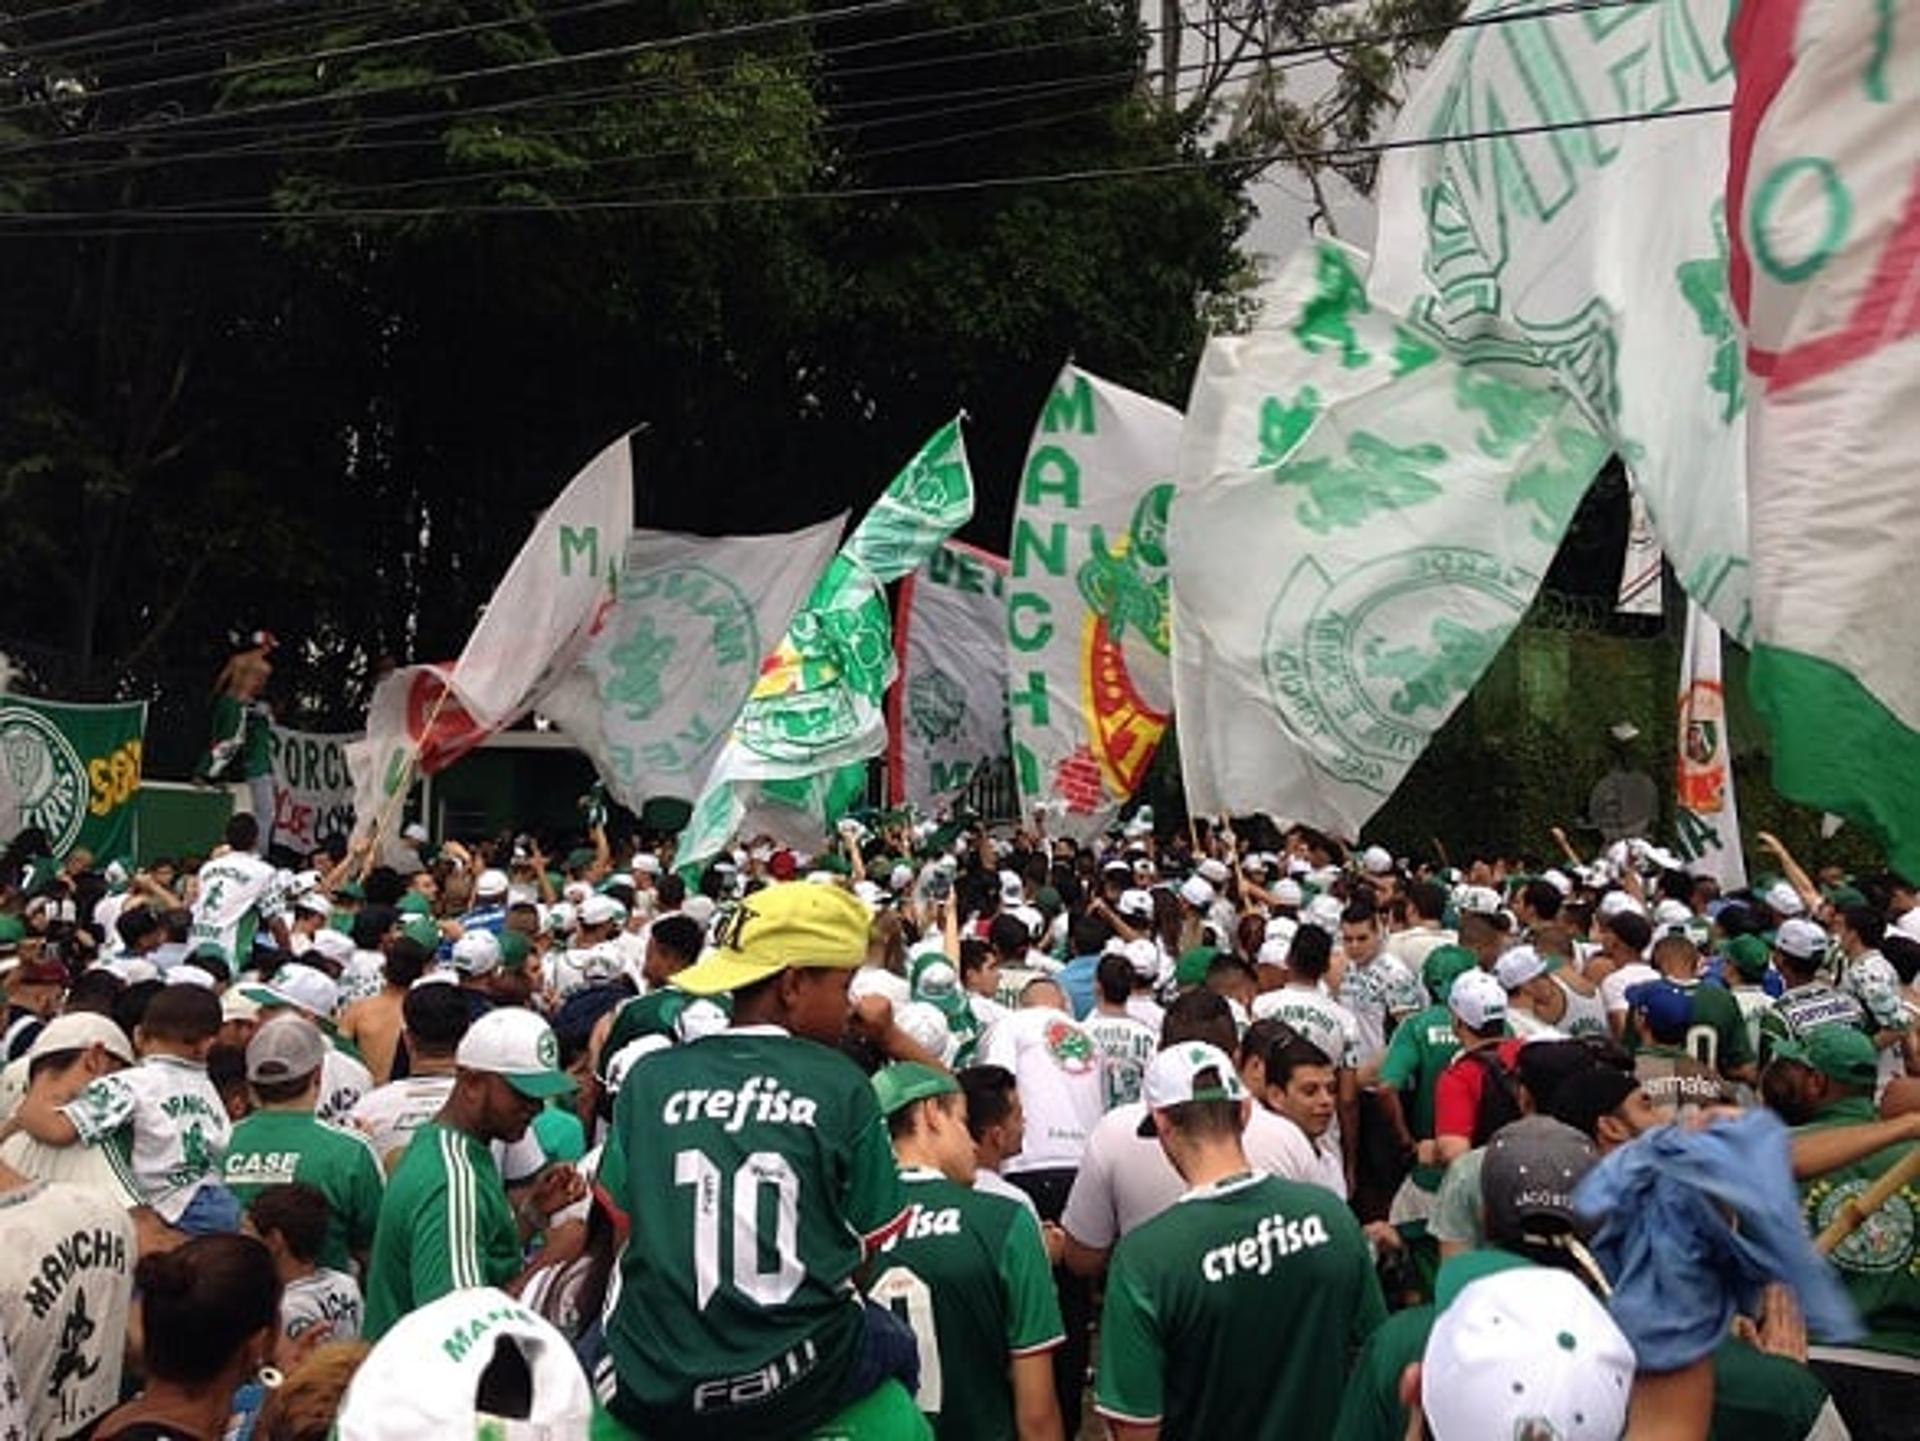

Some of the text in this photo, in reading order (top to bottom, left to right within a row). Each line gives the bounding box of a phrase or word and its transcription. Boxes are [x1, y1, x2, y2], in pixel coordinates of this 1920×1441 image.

[663, 1076, 818, 1133] crefisa
[225, 1152, 301, 1174] CASE
[674, 1149, 807, 1313] 10
[1201, 1212, 1331, 1284] crefisa
[24, 1229, 126, 1321] MANCHA
